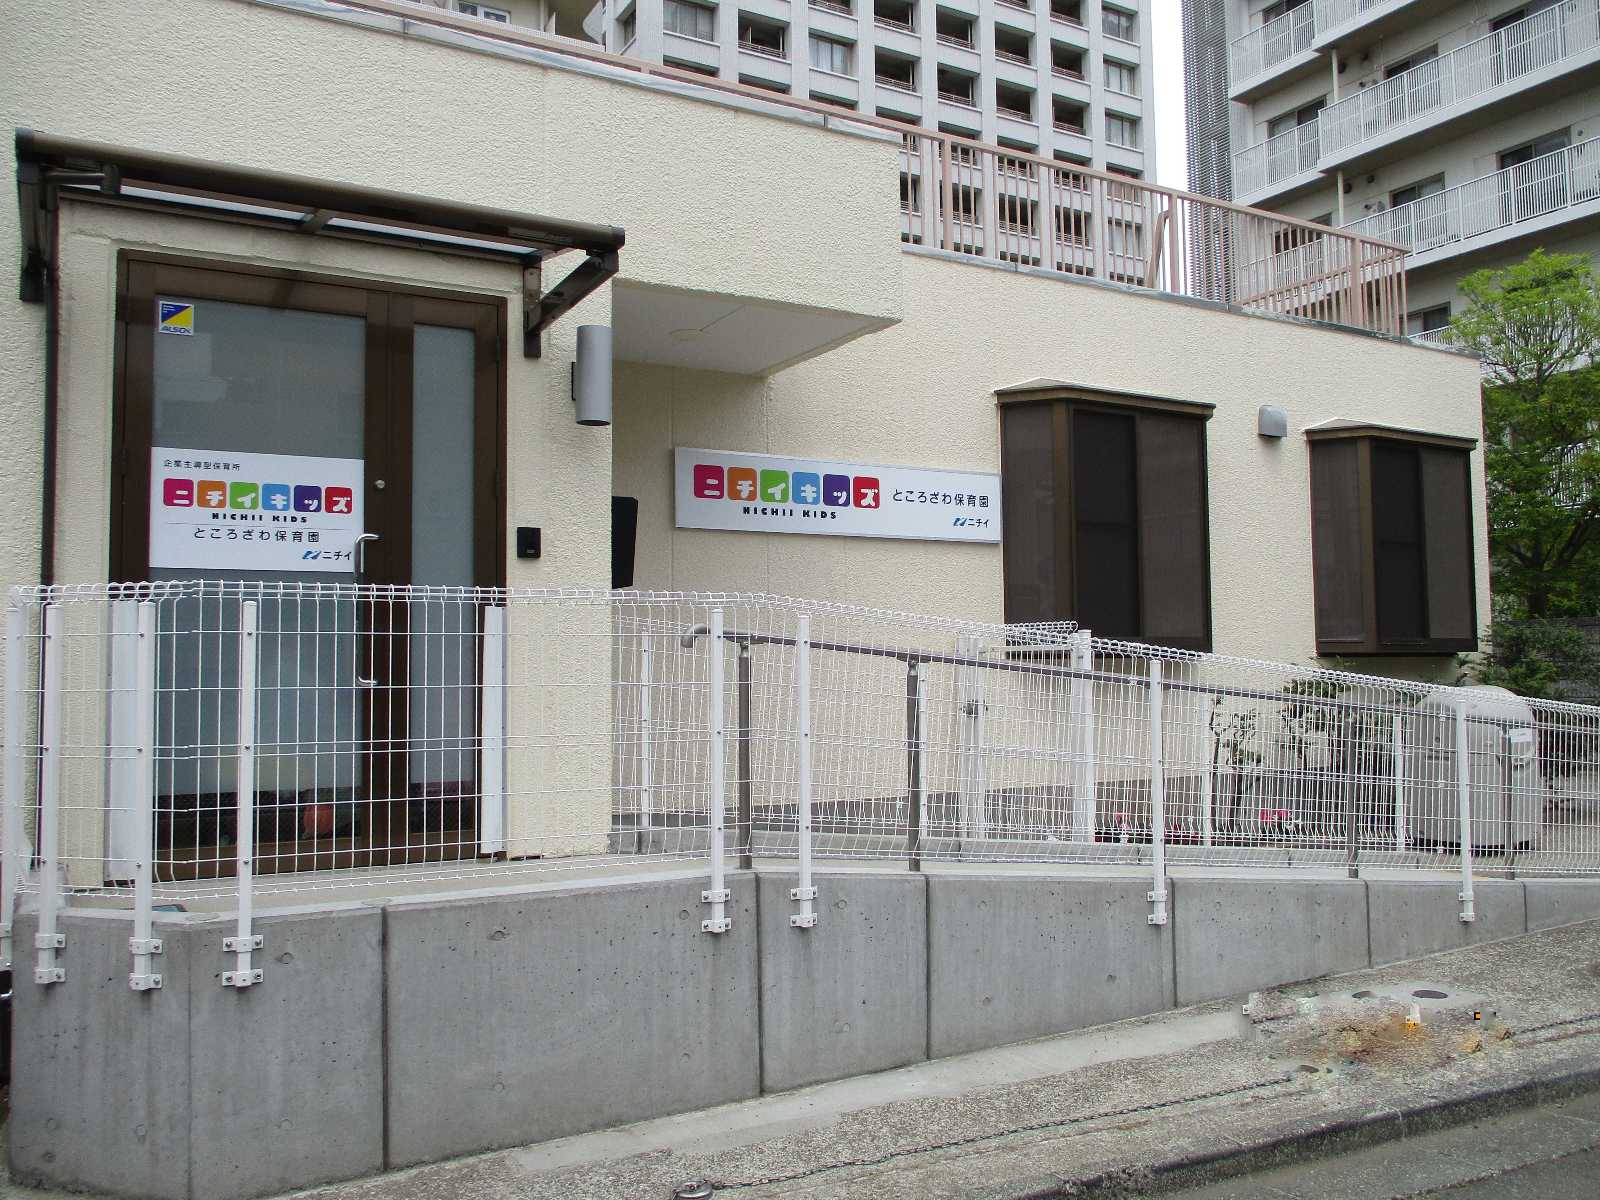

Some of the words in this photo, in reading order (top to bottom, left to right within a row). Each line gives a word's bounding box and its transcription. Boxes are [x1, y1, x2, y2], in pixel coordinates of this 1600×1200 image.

[702, 475, 880, 508] ニチイキッズ
[892, 488, 989, 508] ところざわ保育園
[171, 487, 352, 513] ニチイキッズ
[212, 512, 263, 521] NICHII
[272, 515, 308, 523] KIDS
[743, 506, 794, 516] NICHII
[802, 510, 837, 519] KIDS
[967, 518, 989, 528] ニチイ
[194, 527, 320, 543] ところざわ保育園
[322, 550, 352, 561] ニチイ
